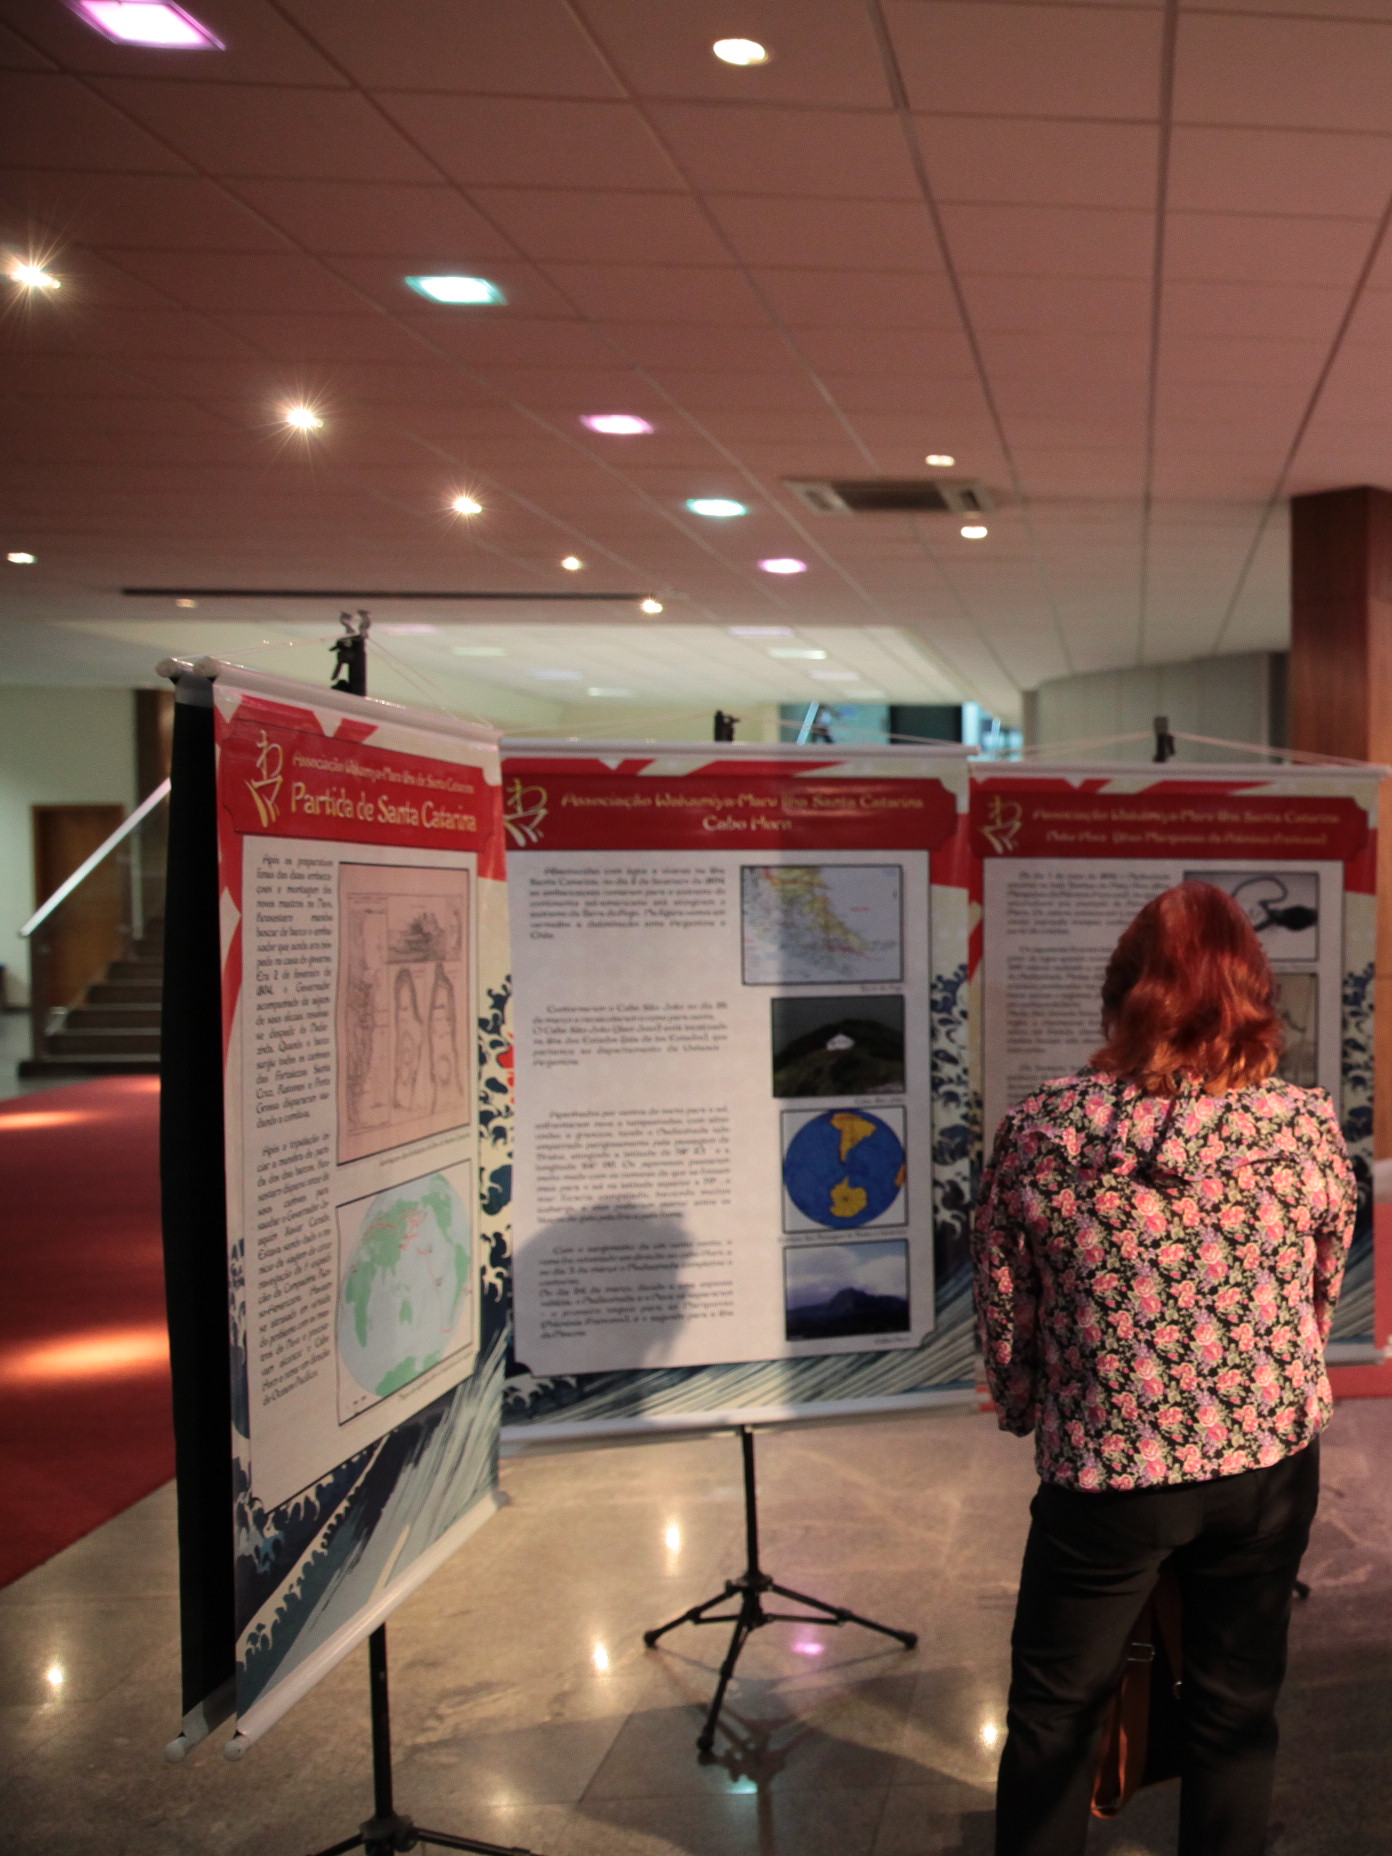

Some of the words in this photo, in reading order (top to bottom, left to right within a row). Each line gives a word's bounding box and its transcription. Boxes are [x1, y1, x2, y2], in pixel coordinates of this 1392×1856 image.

[291, 780, 355, 819] Partida
[356, 790, 375, 822] de
[377, 794, 420, 827] Santa
[421, 799, 478, 833] Catarina
